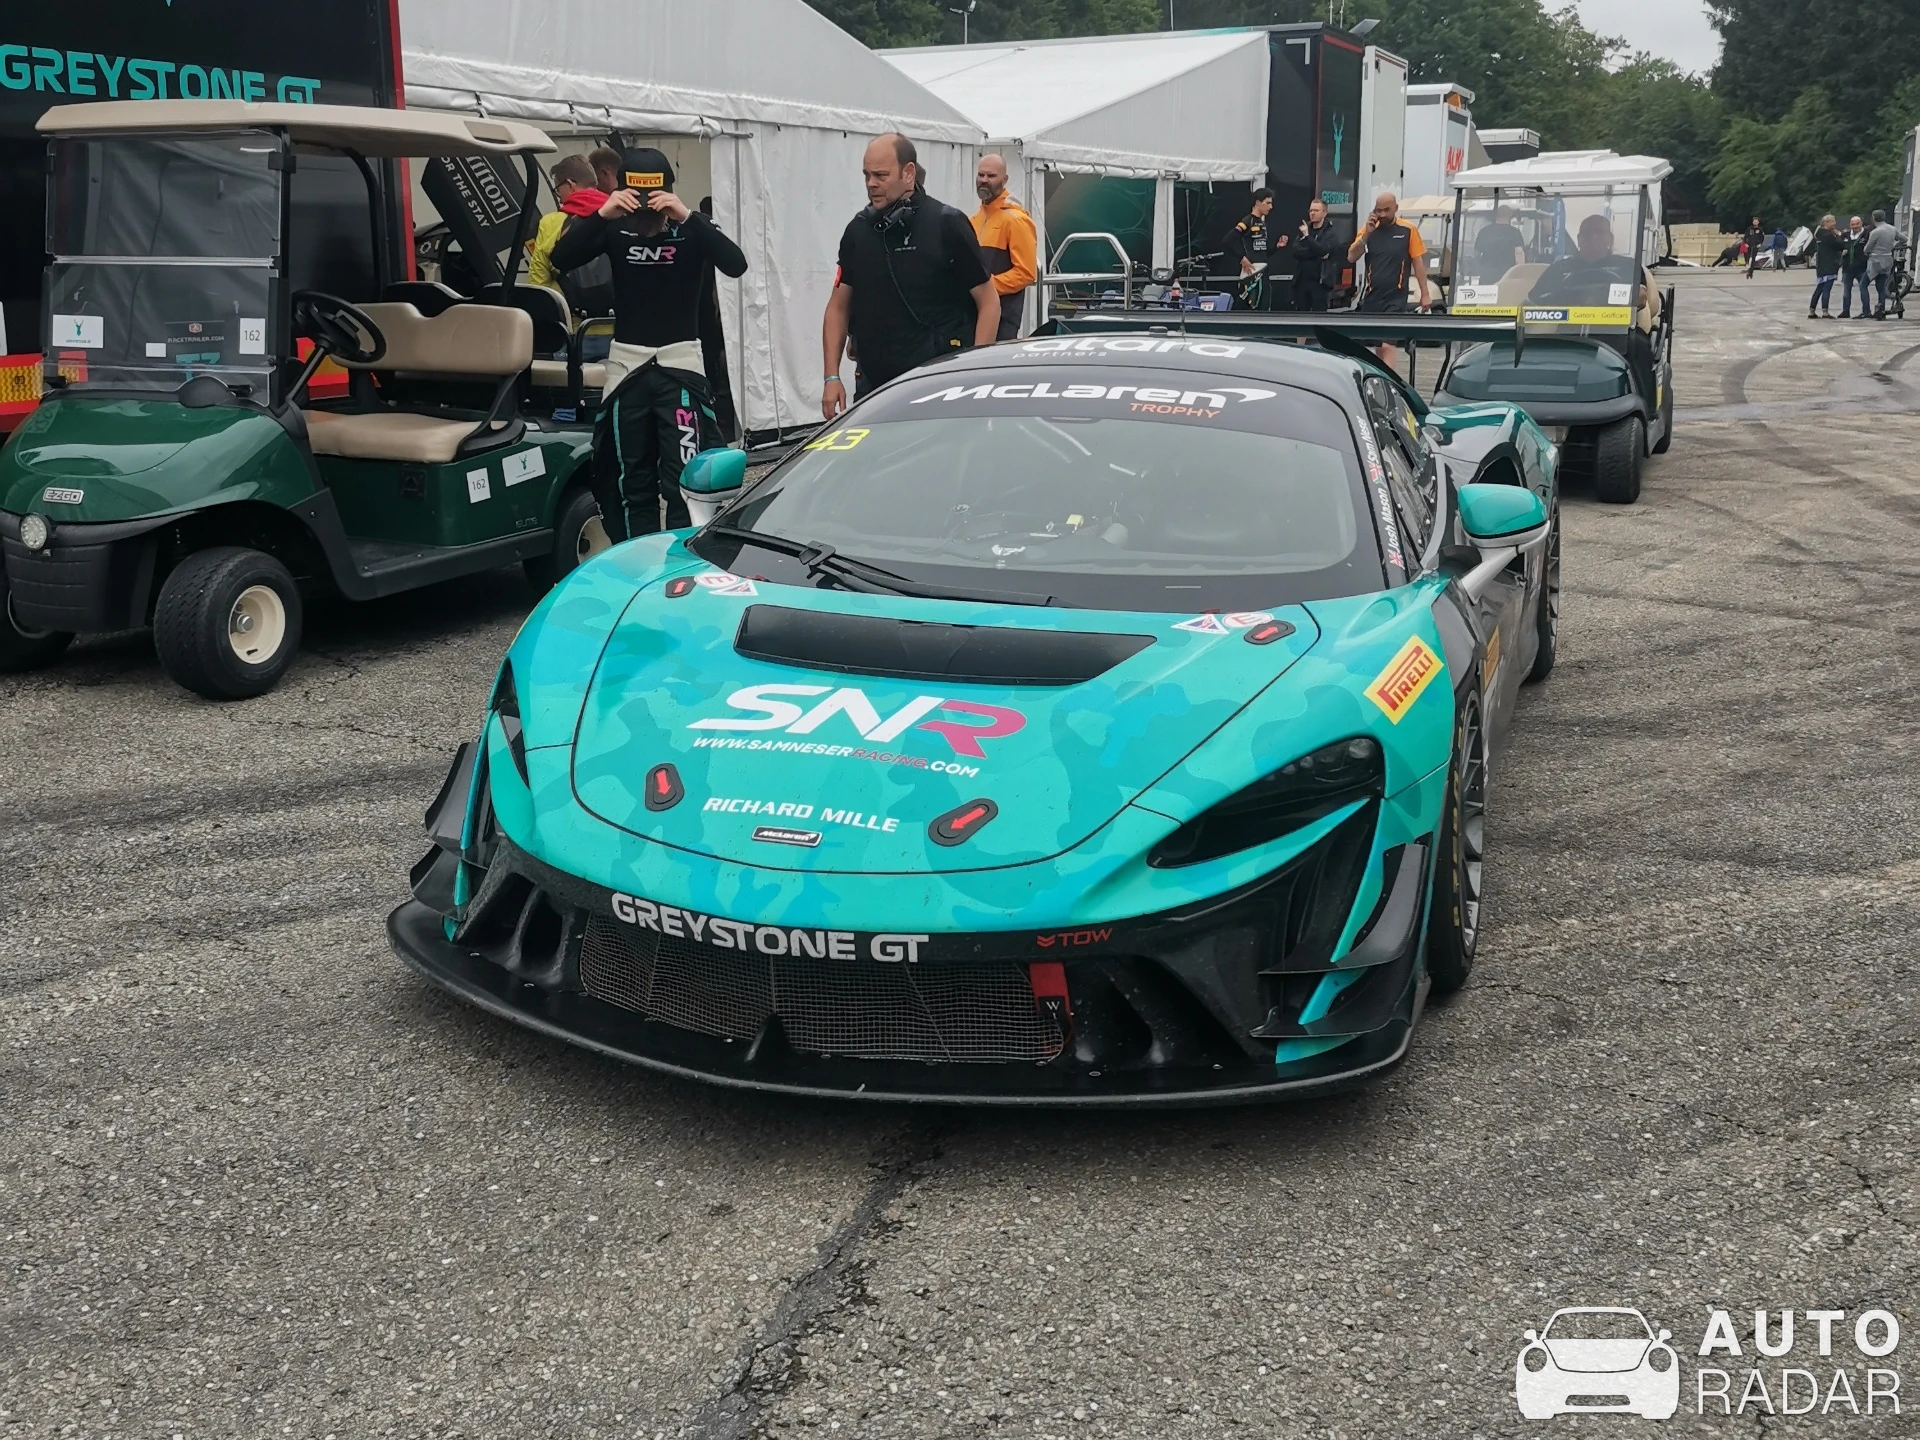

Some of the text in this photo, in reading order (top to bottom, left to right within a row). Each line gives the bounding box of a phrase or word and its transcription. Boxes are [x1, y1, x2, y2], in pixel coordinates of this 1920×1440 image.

[0, 44, 321, 104] GREYSTONE GT
[441, 156, 490, 228] OR THE STAY
[628, 175, 662, 186] PIRELLI
[626, 246, 677, 260] SNR
[1612, 289, 1627, 298] 128
[1525, 311, 1563, 320] DIVACO
[243, 329, 261, 342] 162
[1012, 350, 1108, 360] partners
[1022, 337, 1246, 358] atara
[910, 382, 1228, 409] McLaren
[1130, 403, 1221, 419] TROPHY
[675, 408, 697, 465] SNR
[803, 428, 871, 451] 43
[1357, 416, 1379, 464] Sam Neser
[472, 478, 487, 491] 162
[1378, 488, 1400, 552] Josh Mason
[1376, 645, 1434, 712] PIRELLI
[686, 683, 1027, 760] SNR
[692, 737, 980, 778] WWW.SAMNESERRACING.COM
[702, 797, 900, 833] RICHARD MILLE
[758, 830, 812, 842] McLaren
[611, 891, 930, 963] GREYSTONE GT
[1058, 927, 1113, 947] TOW
